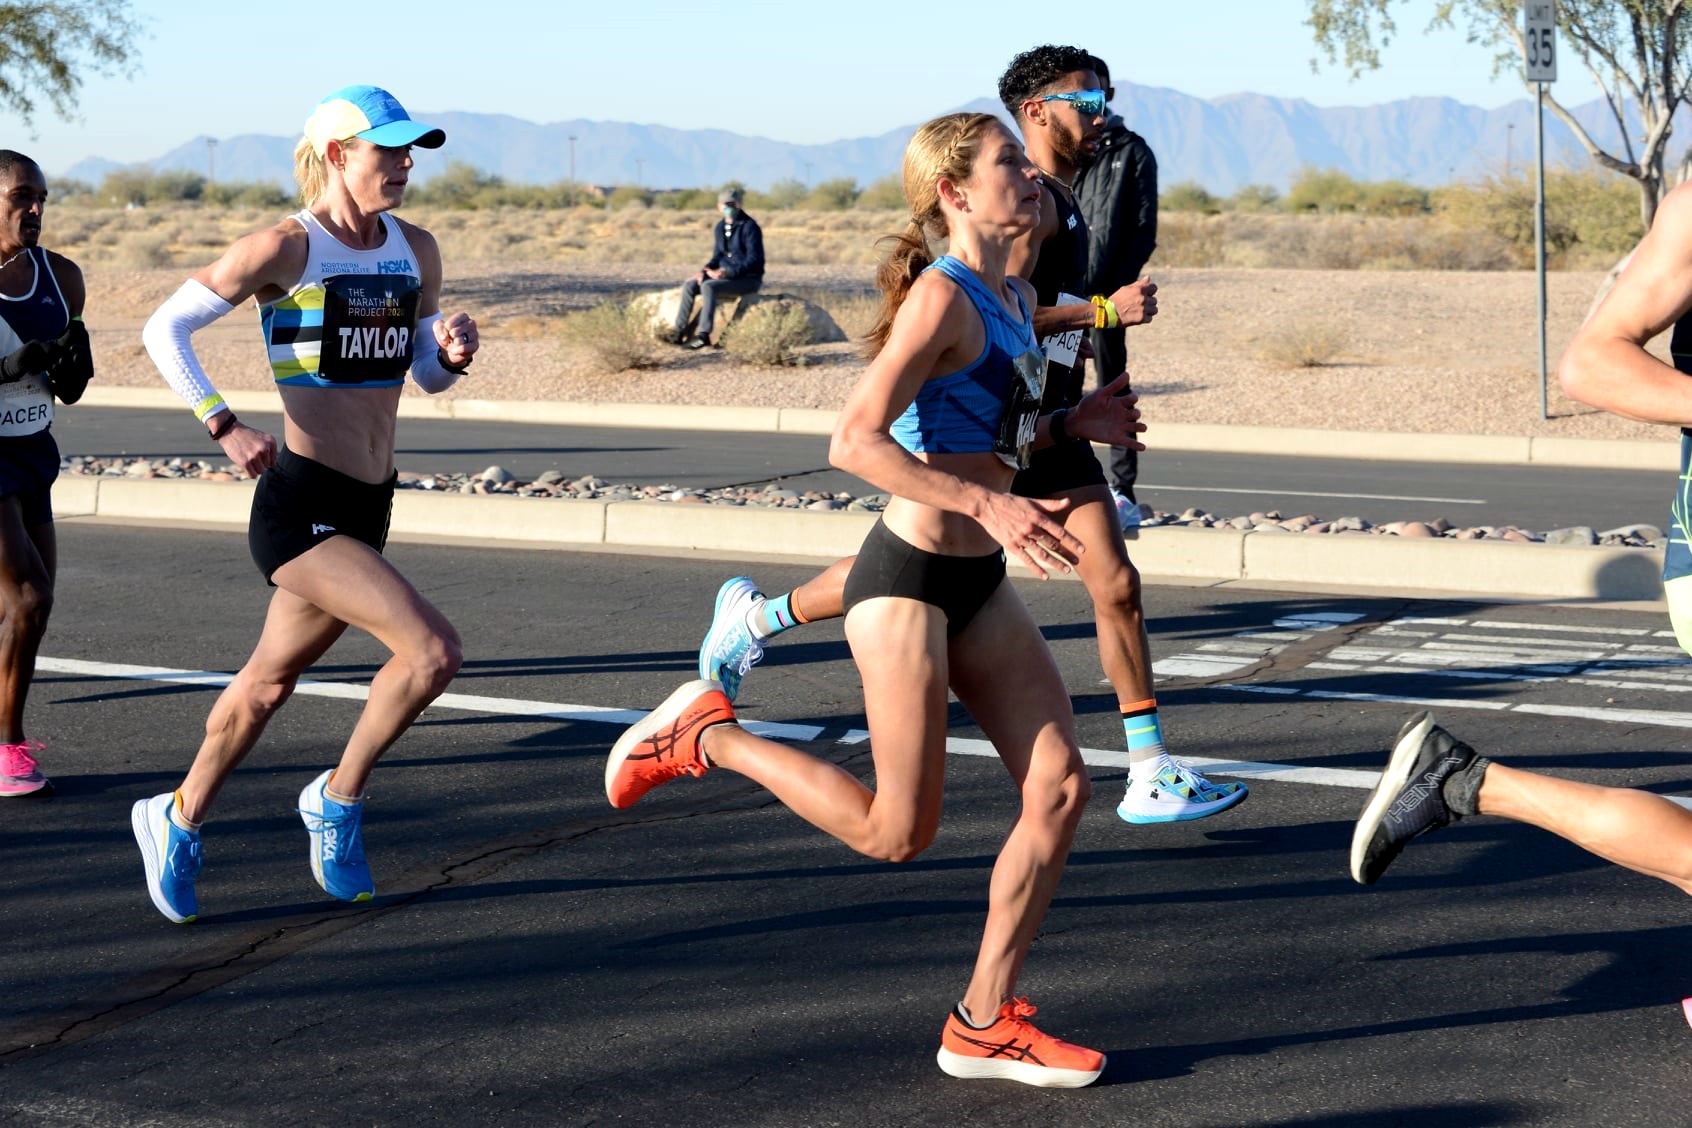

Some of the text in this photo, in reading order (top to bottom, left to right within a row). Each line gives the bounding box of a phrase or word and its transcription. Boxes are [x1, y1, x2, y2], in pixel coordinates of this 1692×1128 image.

[1528, 27, 1553, 68] 35
[377, 259, 413, 274] HOKA
[348, 288, 365, 297] THE
[348, 297, 399, 307] MARATHON
[348, 307, 386, 317] PROJECT
[339, 327, 409, 359] TAYLOR
[0, 404, 48, 425] ACER
